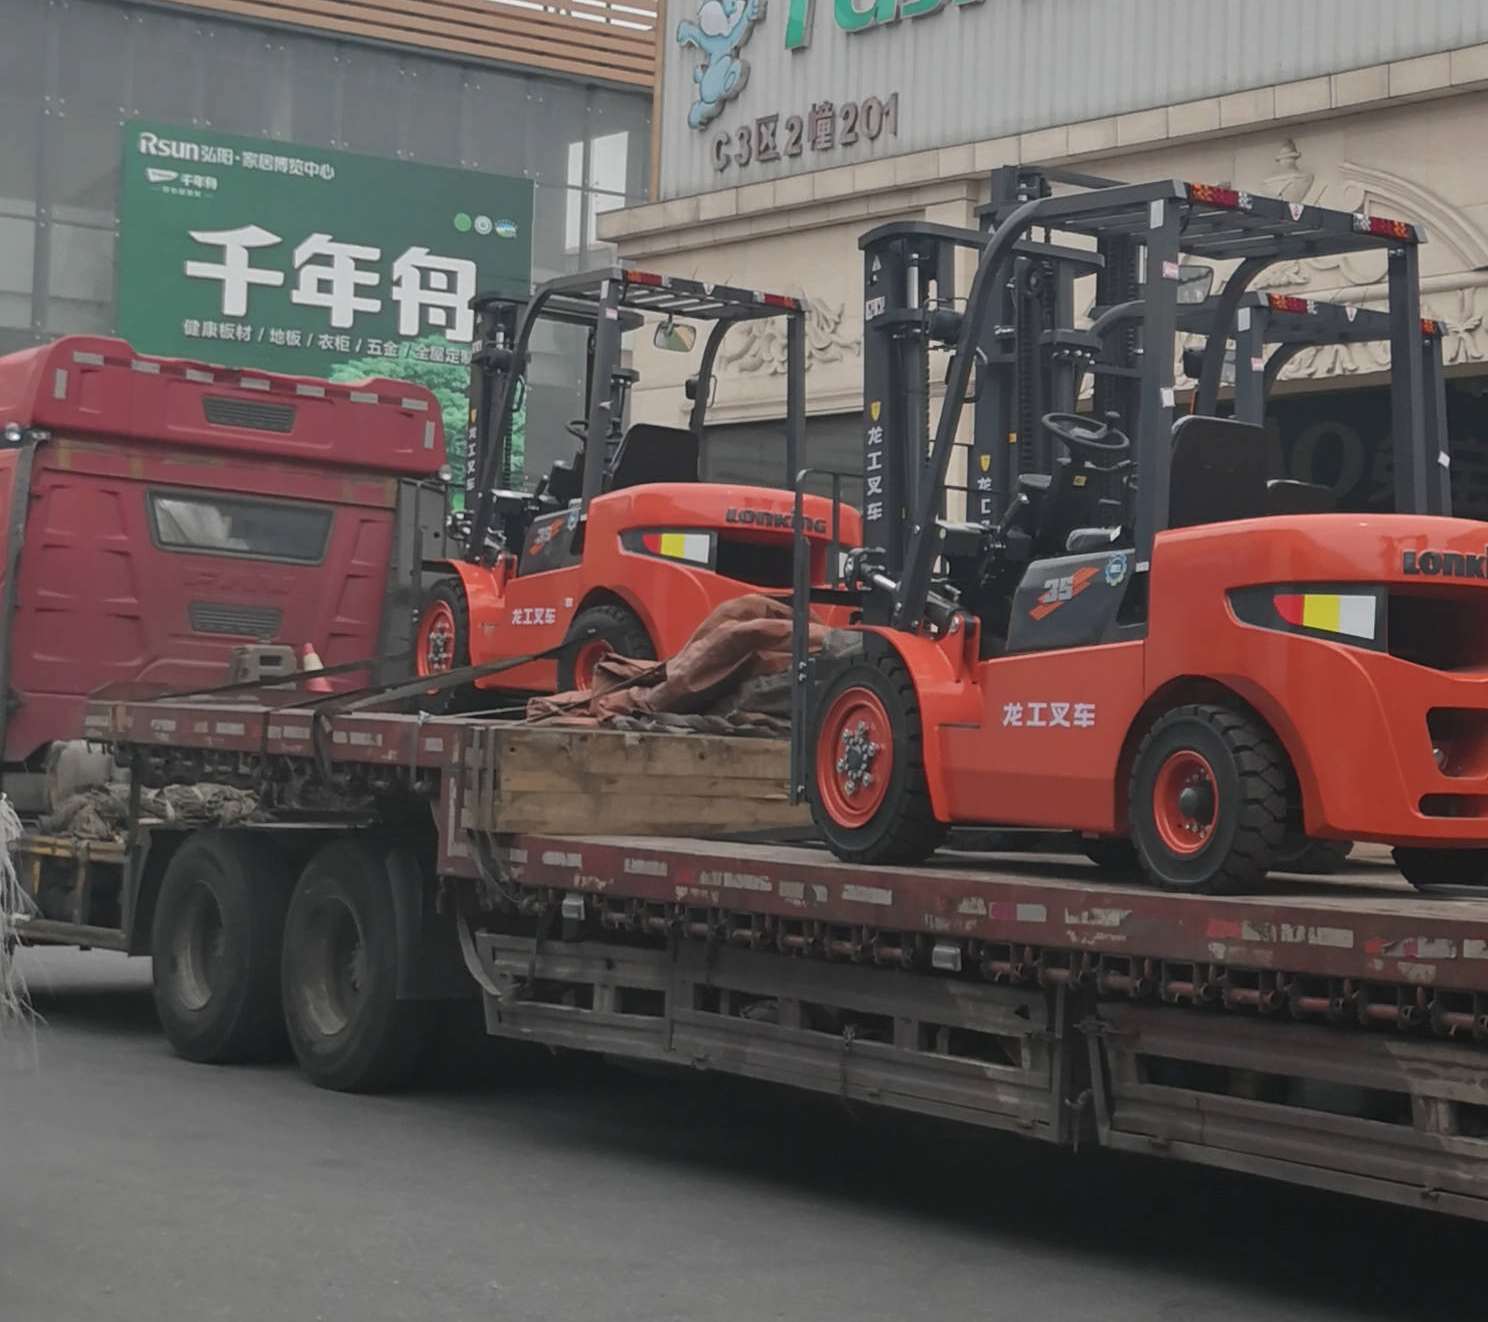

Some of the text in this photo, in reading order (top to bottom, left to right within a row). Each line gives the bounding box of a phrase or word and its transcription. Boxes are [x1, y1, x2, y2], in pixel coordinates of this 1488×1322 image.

[139, 132, 199, 161] Rsun
[711, 92, 899, 173] C3区2幢201
[185, 225, 477, 343] 千年舟
[183, 318, 252, 342] 健康板材
[269, 328, 302, 348] 地板
[318, 334, 350, 353] 衣柜
[367, 338, 399, 357] 五金
[466, 427, 477, 491] 龙工叉车
[867, 426, 883, 521] 龙工叉车
[1043, 576, 1074, 605] 35
[511, 606, 557, 626] 龙工叉车
[1002, 701, 1096, 728] 龙工叉车
